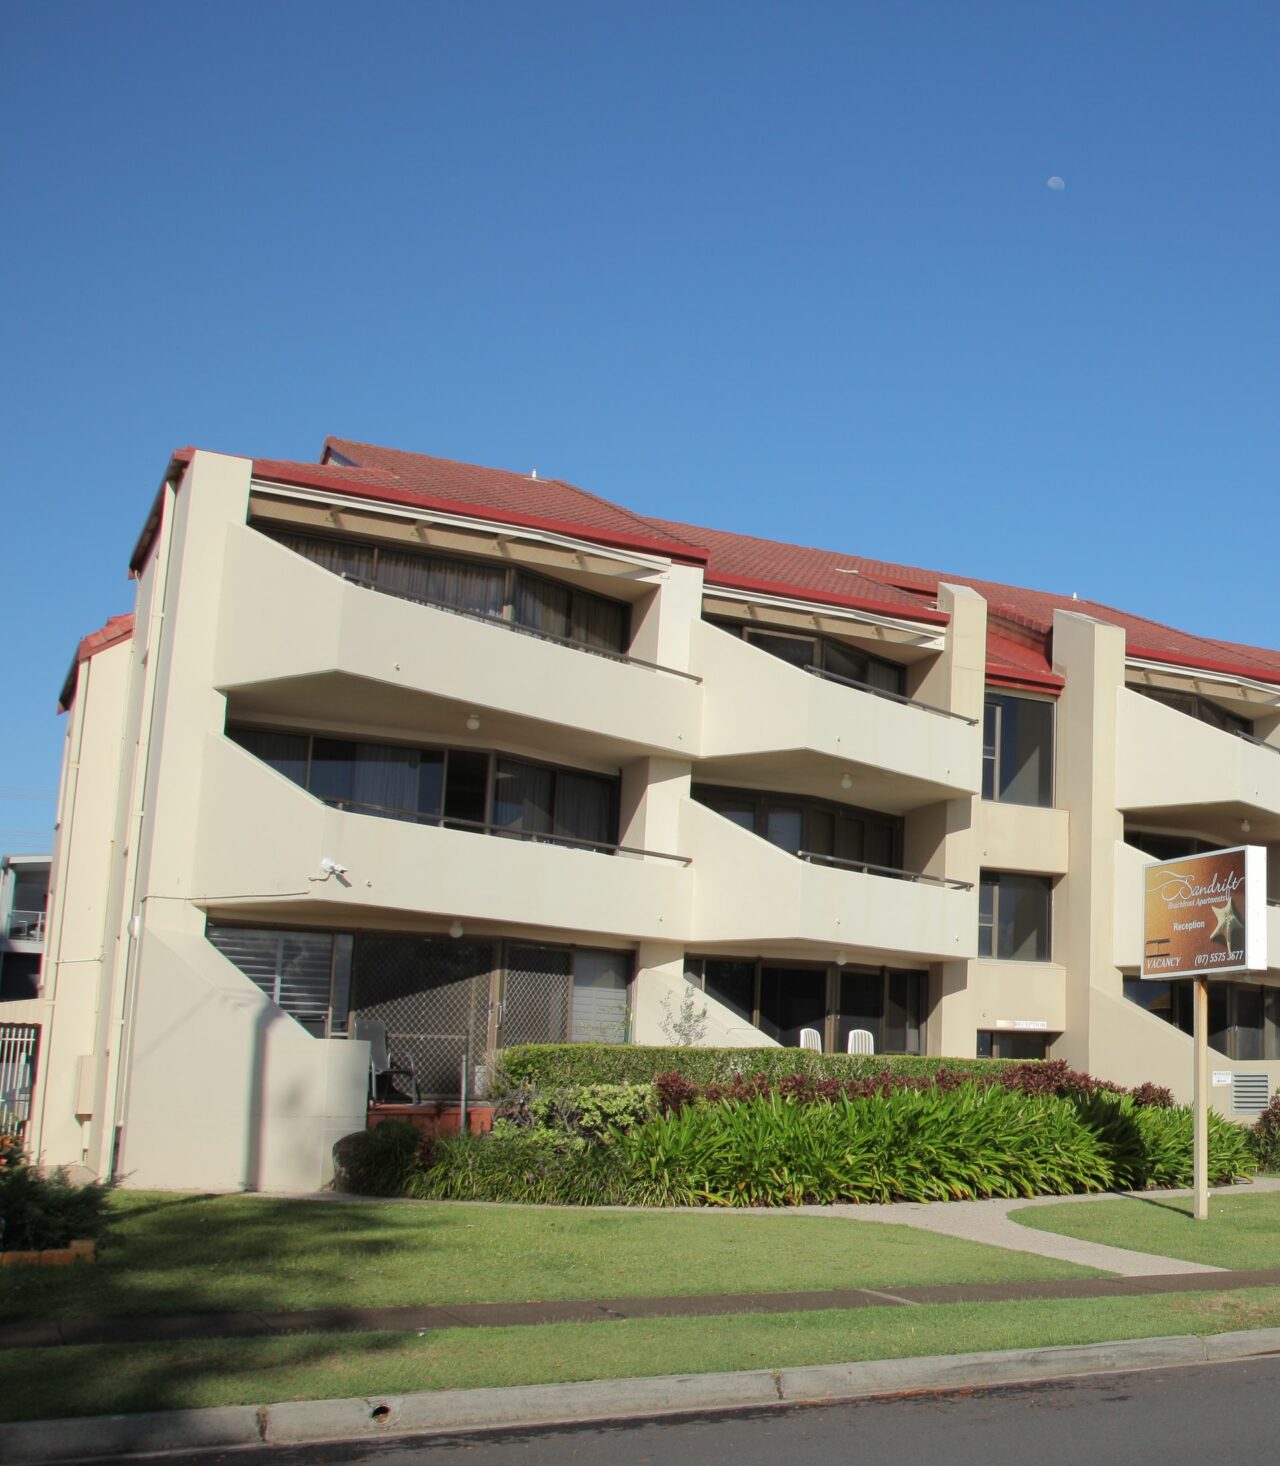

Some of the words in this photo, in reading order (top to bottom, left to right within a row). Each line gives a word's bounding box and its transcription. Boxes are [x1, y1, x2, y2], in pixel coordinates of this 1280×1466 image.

[1160, 870, 1245, 901] Sandrift
[1195, 895, 1226, 907] Apartments
[1173, 920, 1205, 932] Reception
[1147, 957, 1181, 969] VACANCY
[1194, 954, 1209, 967] (07)
[1209, 952, 1226, 963] 5575
[1227, 950, 1244, 961] 3677
